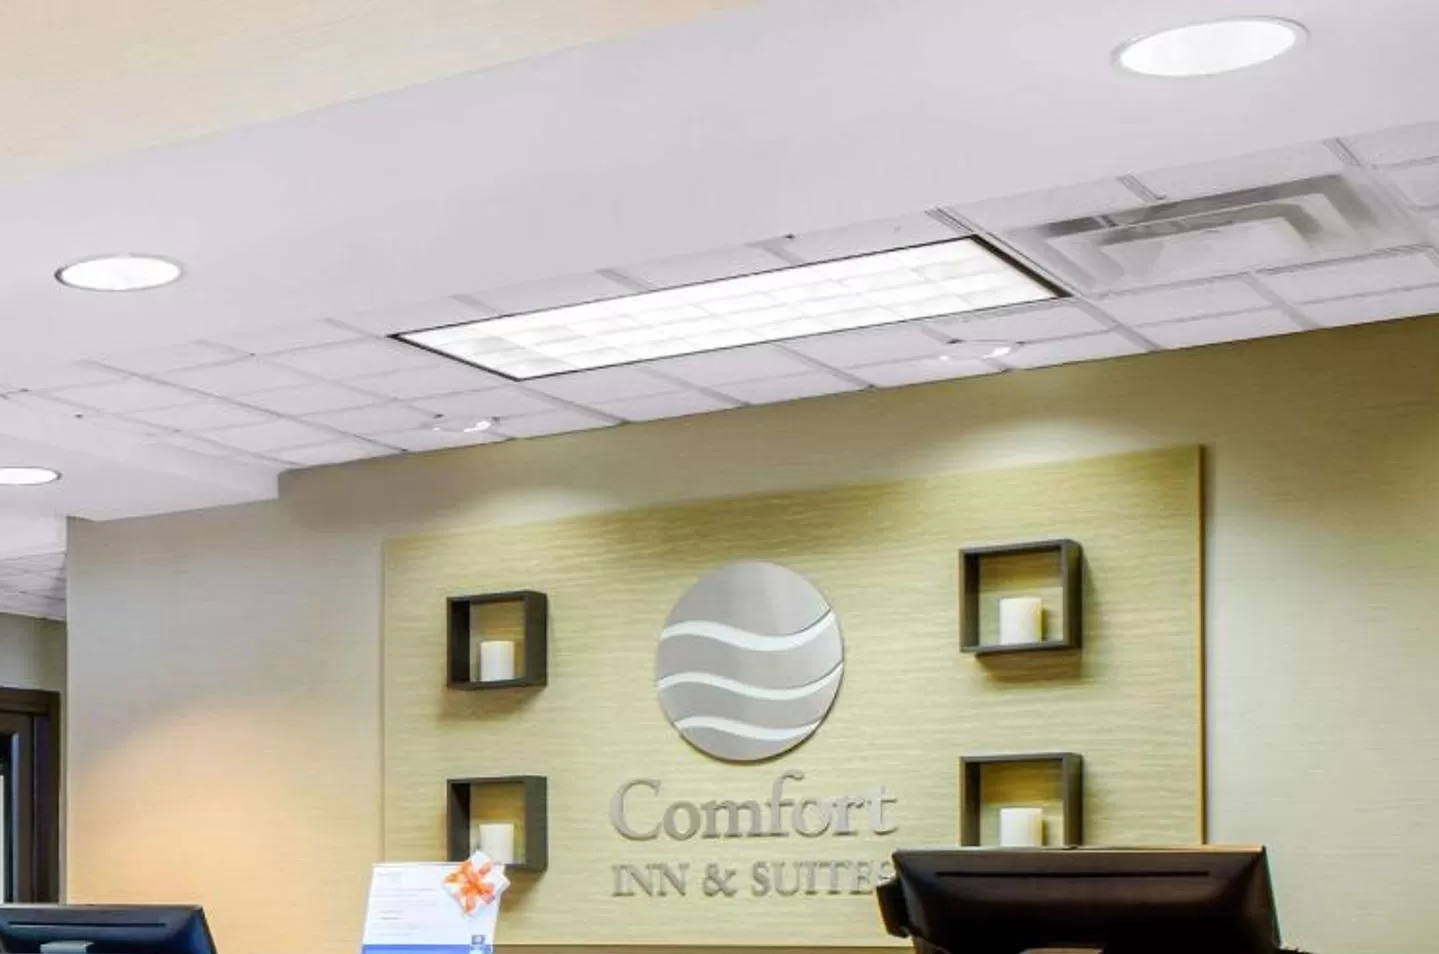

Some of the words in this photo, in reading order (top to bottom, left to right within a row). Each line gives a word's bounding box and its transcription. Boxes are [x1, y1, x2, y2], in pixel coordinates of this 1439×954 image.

[610, 769, 899, 841] Comfort
[611, 862, 690, 897] INN
[702, 862, 738, 897] &
